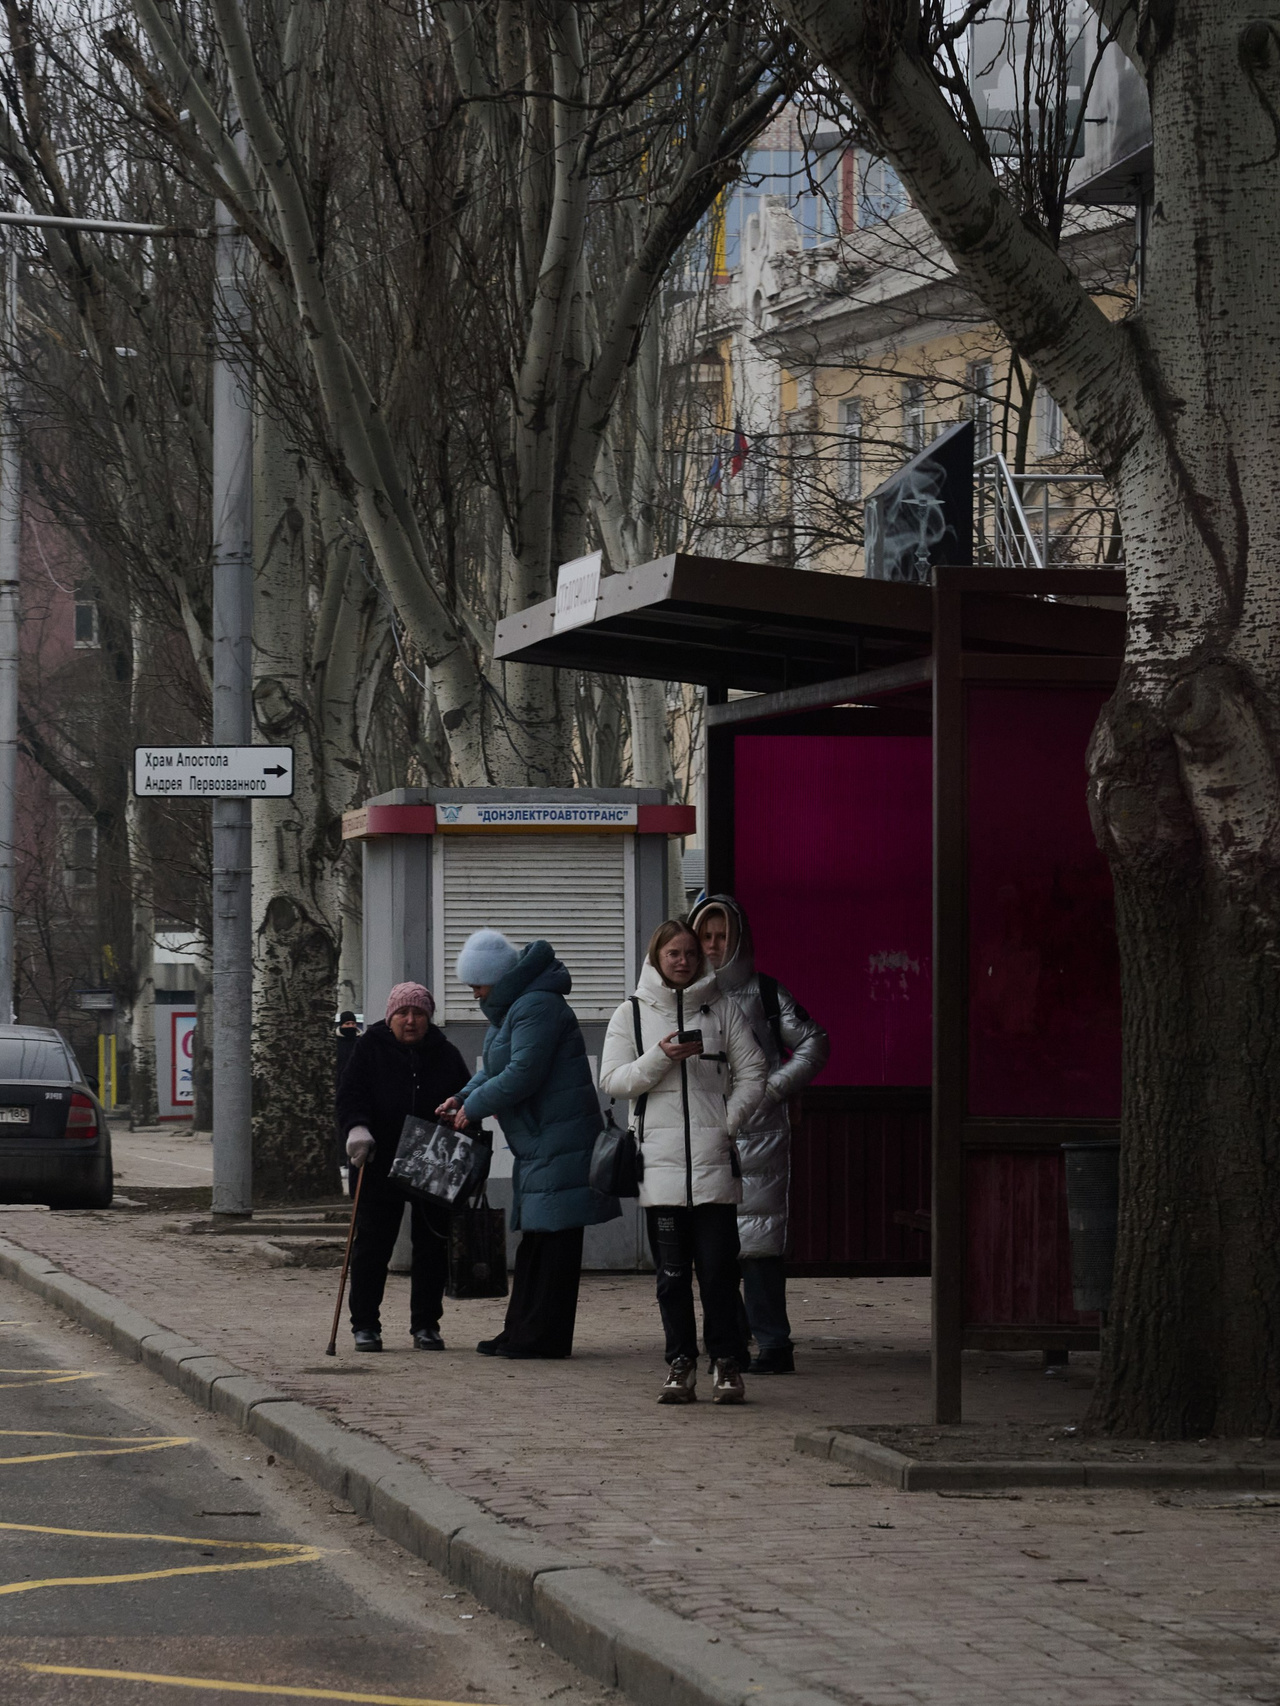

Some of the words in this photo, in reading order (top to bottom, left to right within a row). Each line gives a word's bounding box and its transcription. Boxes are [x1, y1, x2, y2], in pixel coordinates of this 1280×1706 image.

[145, 752, 173, 770] Храм
[177, 752, 228, 767] Апостола
[145, 776, 182, 793] Андрея
[190, 776, 267, 793] Первозванного
[8, 1107, 27, 1120] 180
